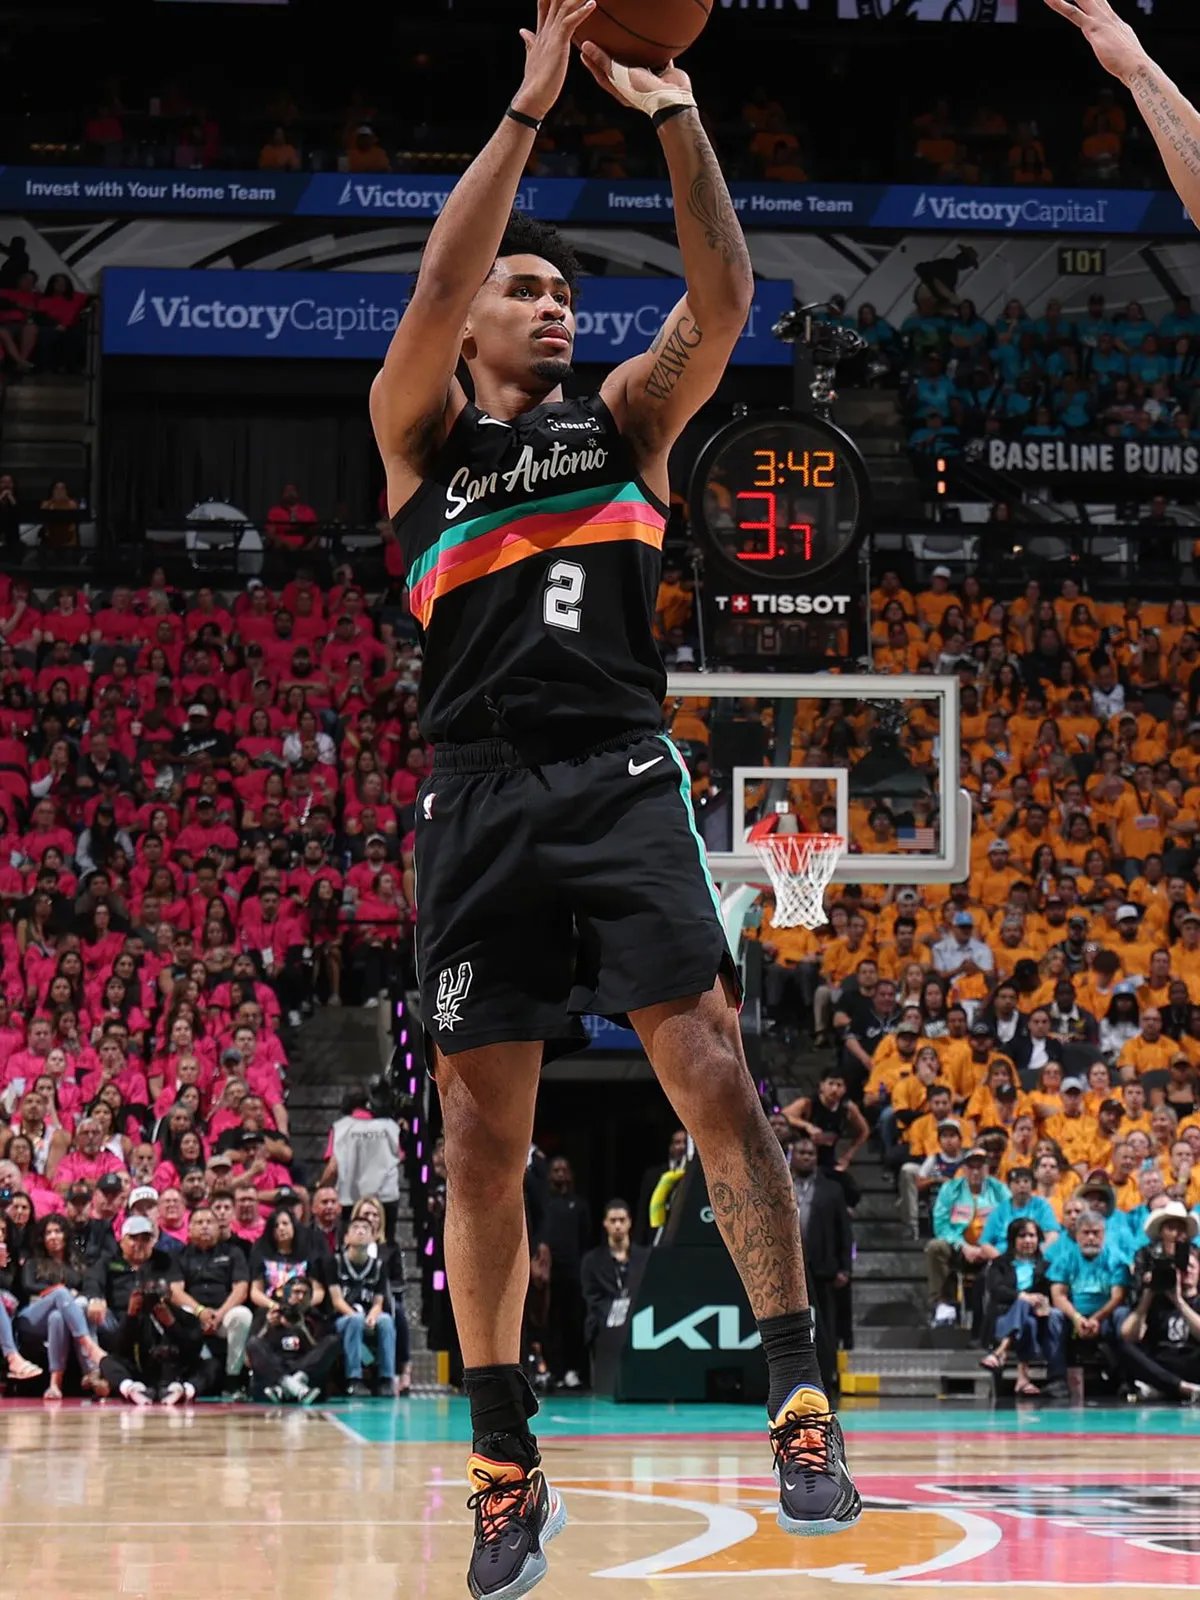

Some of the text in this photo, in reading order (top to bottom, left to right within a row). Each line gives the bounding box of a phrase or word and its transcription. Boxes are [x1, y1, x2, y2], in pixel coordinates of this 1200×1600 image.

[26, 180, 276, 200] Invest with Your Home Team
[608, 193, 661, 209] Invest
[751, 196, 803, 211] Home
[809, 196, 853, 212] Team
[1062, 250, 1102, 273] 101
[151, 296, 400, 340] VictoryCapita
[754, 450, 835, 487] 3:42
[989, 439, 1200, 474] BASELINE BUMS
[445, 438, 609, 520] San Antonio
[736, 491, 812, 561] 3.7
[543, 559, 587, 633] 2
[752, 594, 851, 614] TISSOT
